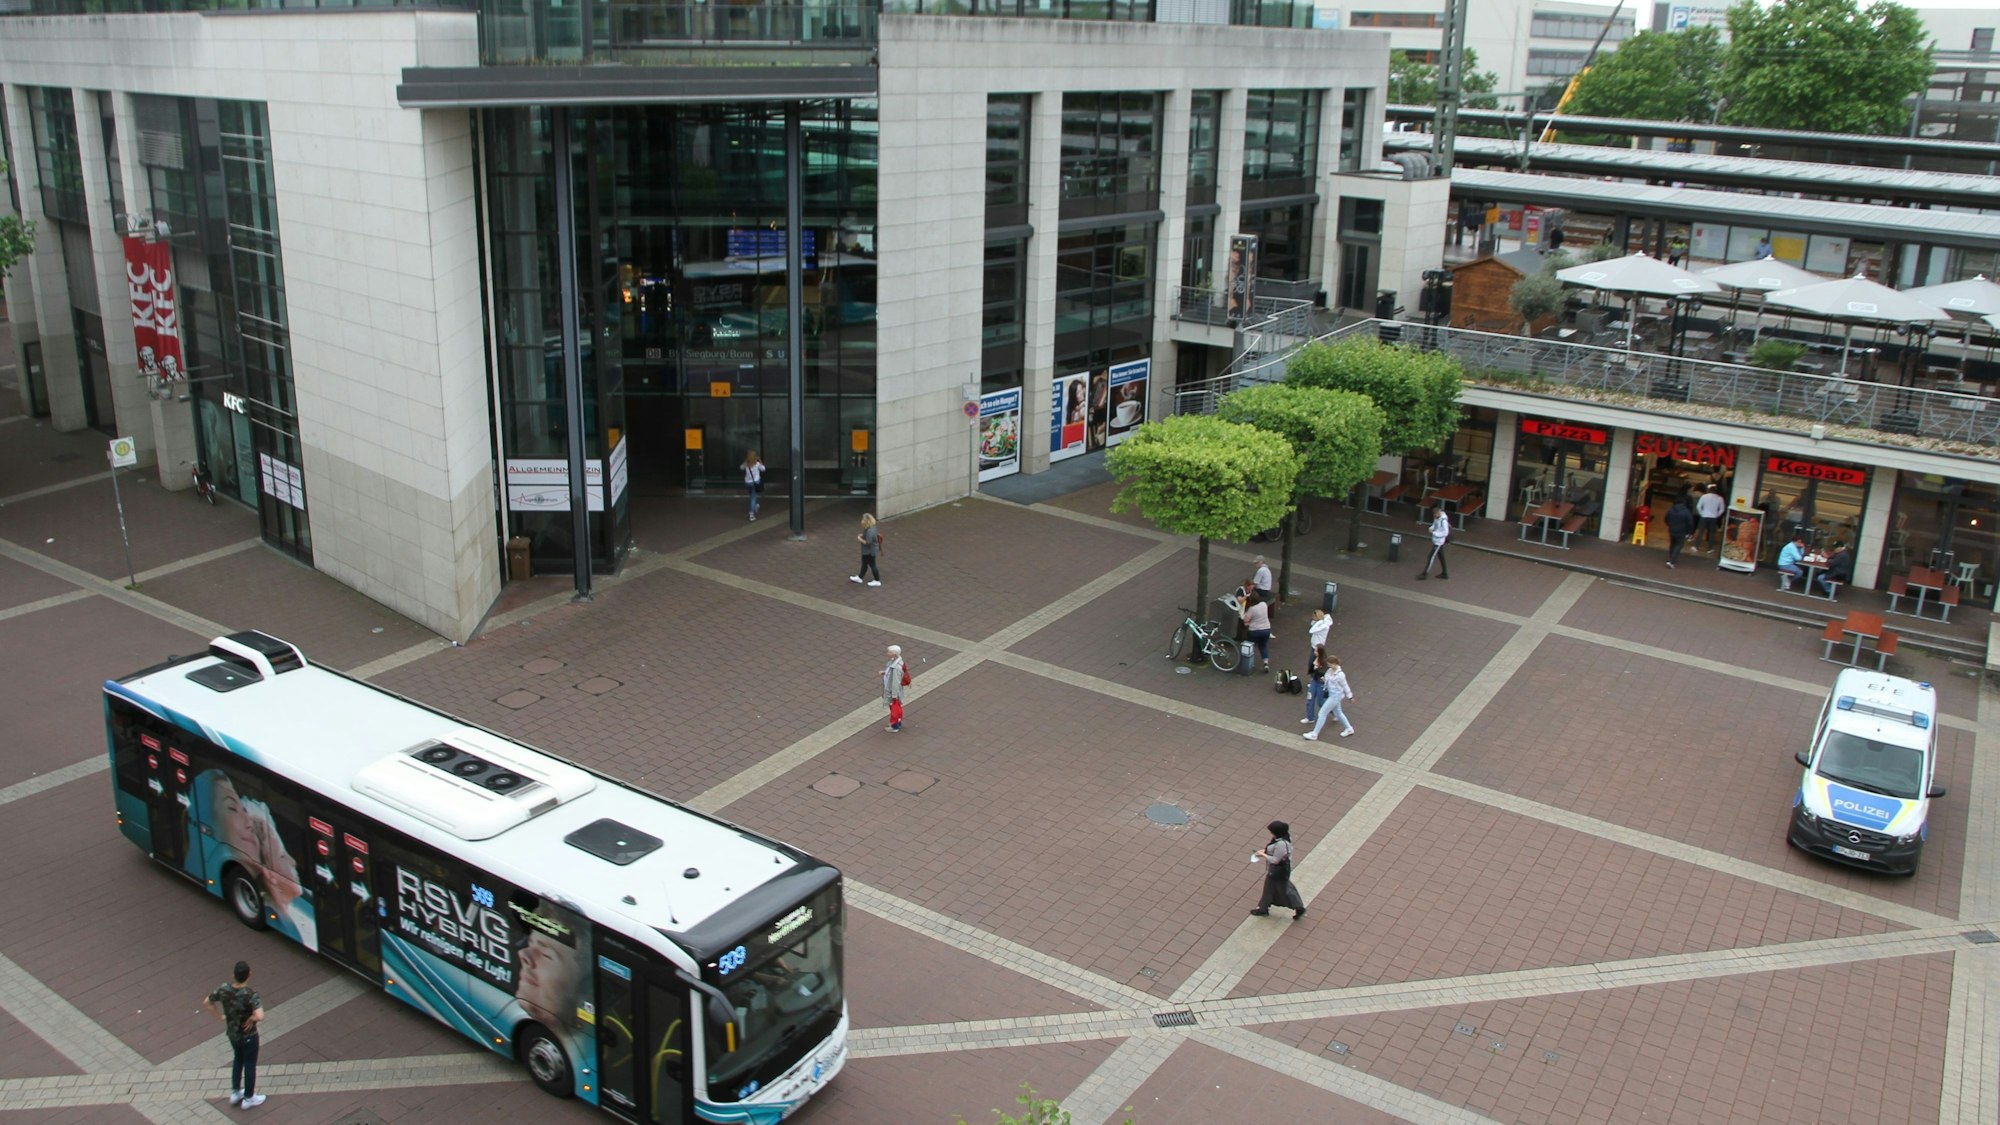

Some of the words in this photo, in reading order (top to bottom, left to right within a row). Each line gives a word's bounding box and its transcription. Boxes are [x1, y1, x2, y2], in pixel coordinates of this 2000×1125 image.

[127, 261, 156, 330] KFC
[150, 269, 178, 338] KFC
[686, 350, 754, 360] Siegburg/Bonn
[223, 391, 244, 414] KFC
[1536, 423, 1592, 442] Pizza
[1637, 434, 1736, 468] SULTAN
[509, 466, 601, 474] ALLGEMEINMZIN
[1777, 460, 1855, 482] Kebap
[1834, 799, 1890, 820] POLIZEI
[396, 865, 510, 944] RSVG
[398, 894, 511, 964] HYBRID
[400, 916, 418, 936] Wir
[419, 928, 465, 961] reinigen
[465, 951, 484, 968] die
[484, 959, 512, 983] Luft!
